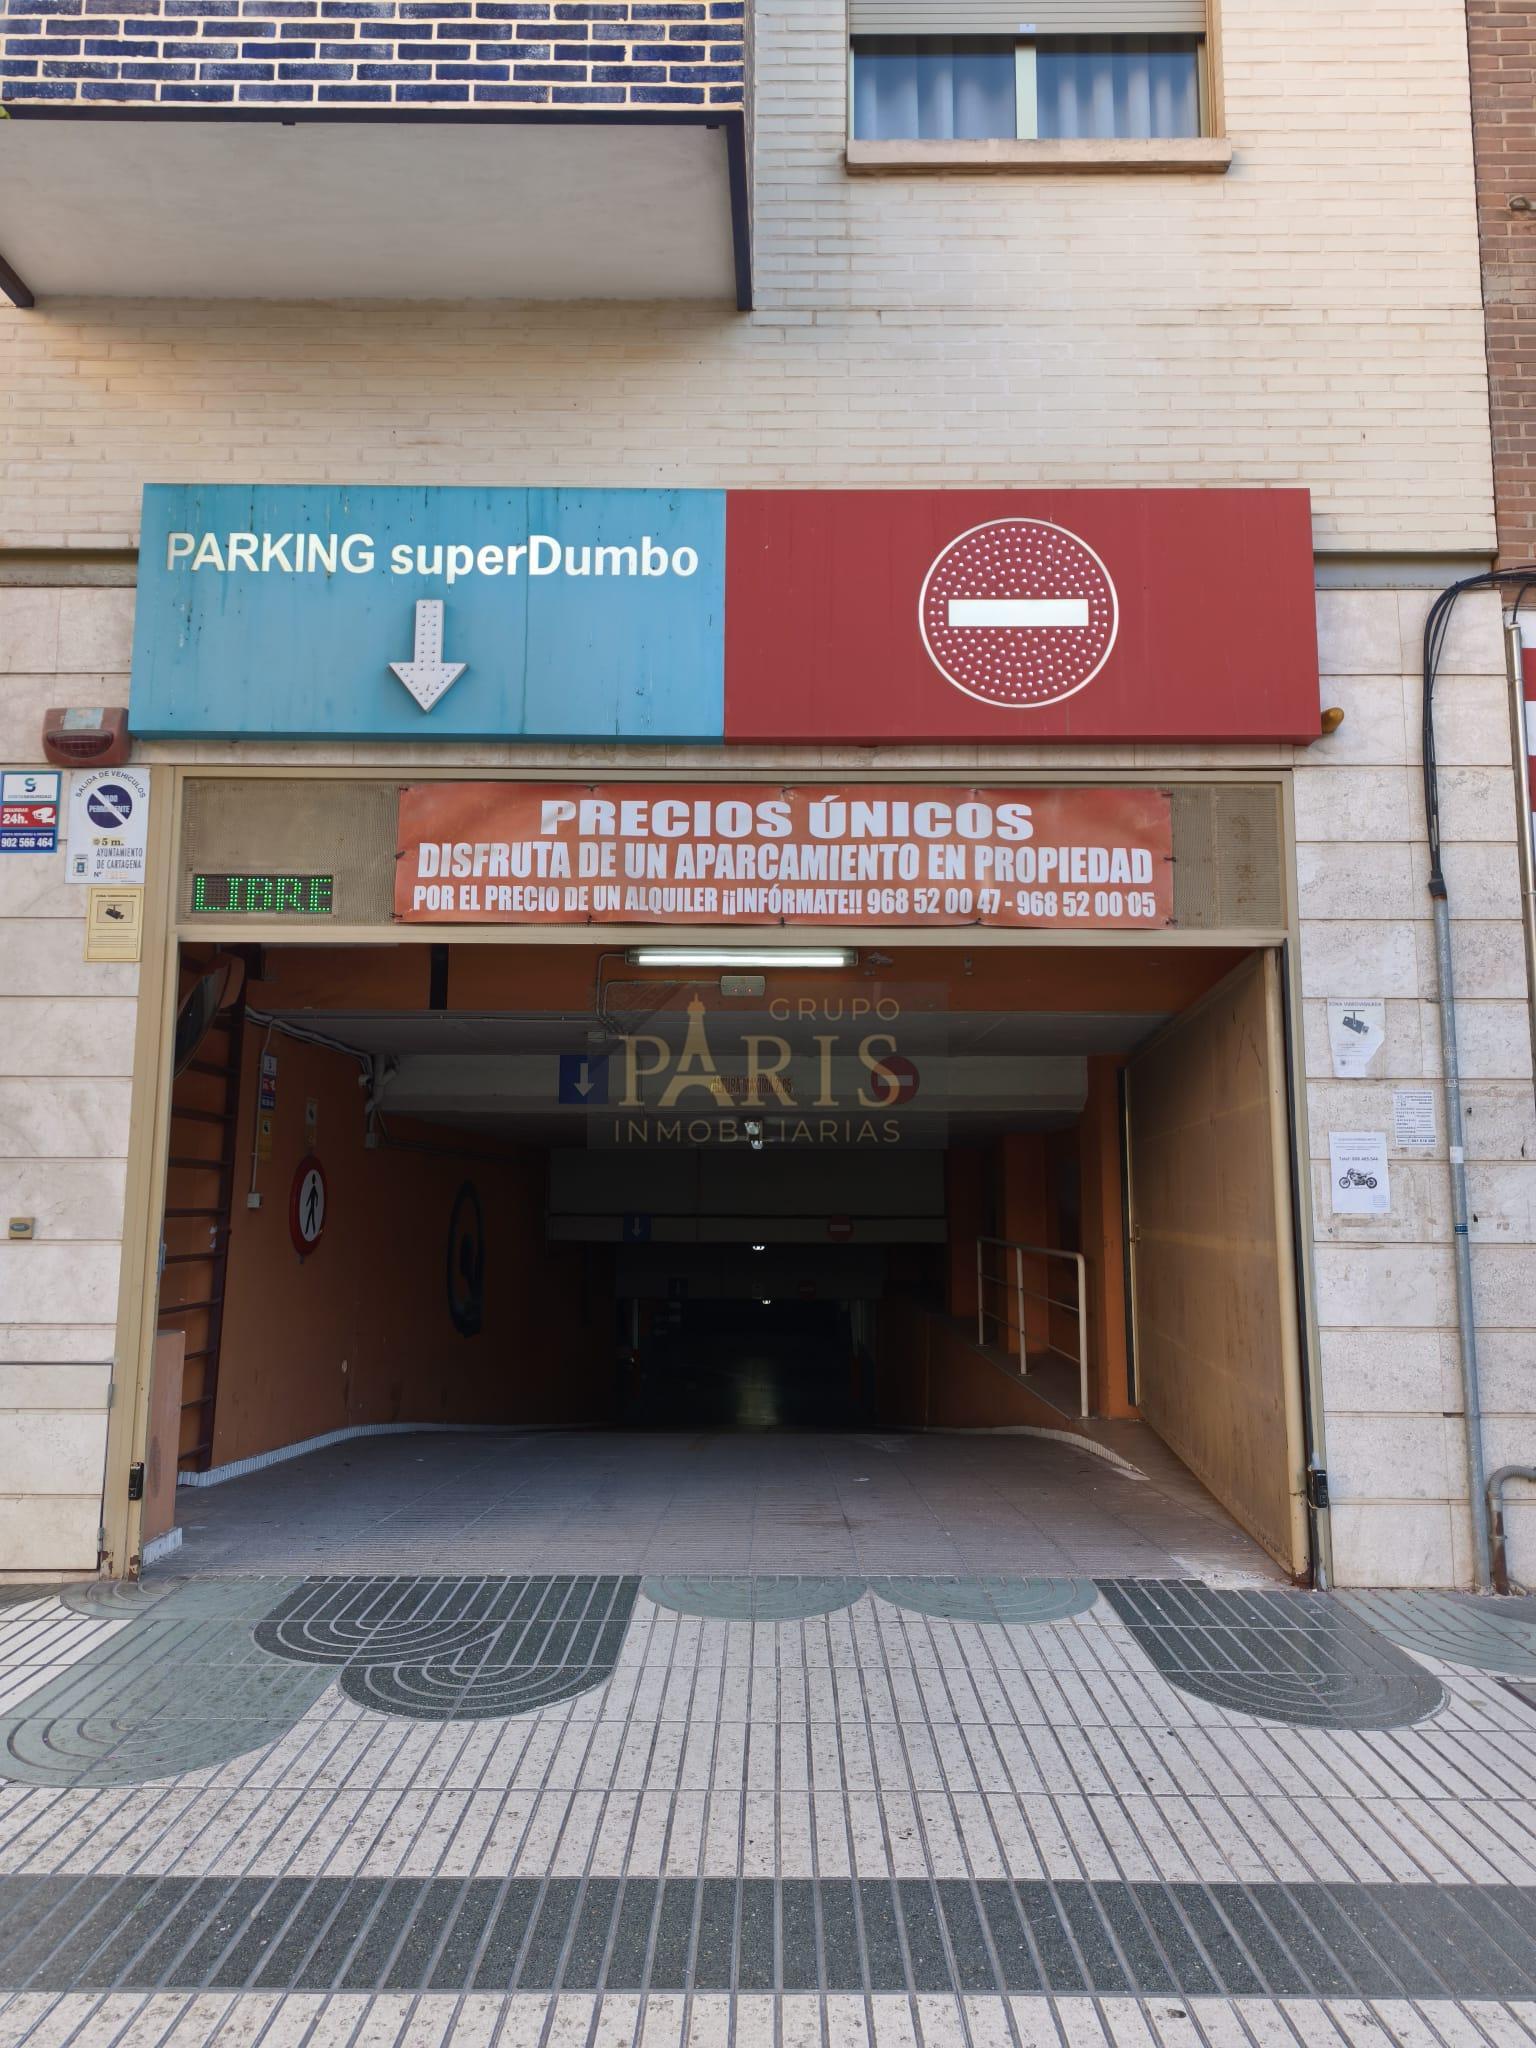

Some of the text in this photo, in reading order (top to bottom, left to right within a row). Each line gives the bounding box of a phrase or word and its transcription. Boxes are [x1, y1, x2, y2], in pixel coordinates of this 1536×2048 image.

[166, 532, 699, 584] PARKING superDumbo
[76, 775, 97, 797] SALIDA
[98, 770, 110, 779] DE
[2, 813, 29, 824] 24h.
[540, 795, 1034, 841] PRECIOS ÚNICOS
[1, 837, 53, 848] 902 566 464
[96, 848, 143, 857] AYUNTAMIENTO
[96, 859, 142, 869] DE CARTAGENA
[417, 842, 1153, 884] DISFRUTA DE UN APARCAMIENTO EN PROPIEDAD
[195, 877, 332, 911] LIBRE
[413, 885, 455, 911] POR
[459, 885, 480, 911] EL
[485, 885, 560, 912] PRECIO
[564, 886, 589, 912] DE
[593, 886, 621, 912] UN
[624, 886, 718, 914] ALQUILER
[867, 888, 909, 914] 968
[913, 888, 941, 914] 52
[944, 888, 973, 914] 00
[977, 889, 1001, 915] 47
[1016, 891, 1058, 916] 968
[1062, 891, 1090, 917] 52
[1095, 891, 1122, 917] 00
[1127, 891, 1156, 917] 05
